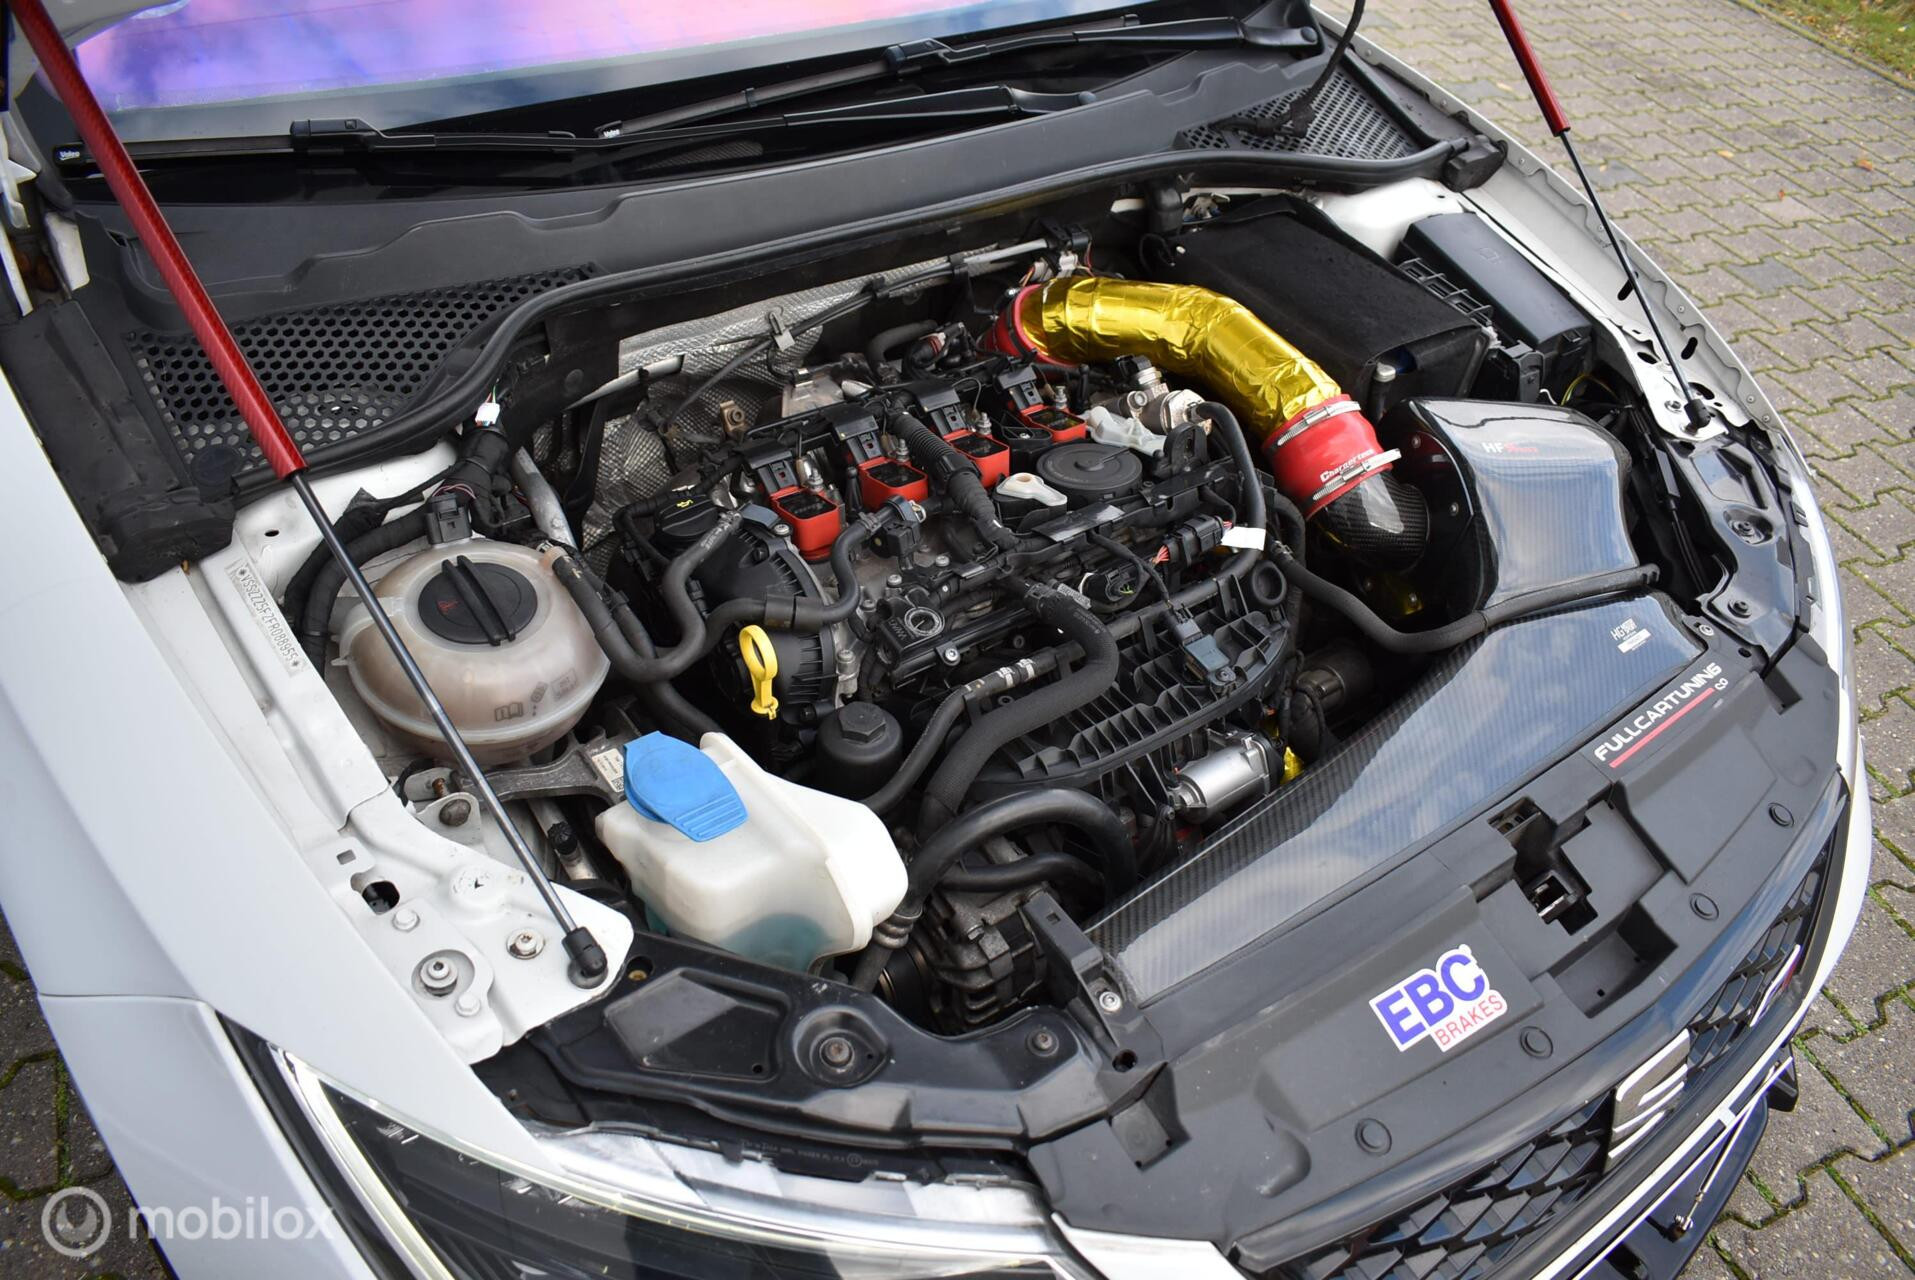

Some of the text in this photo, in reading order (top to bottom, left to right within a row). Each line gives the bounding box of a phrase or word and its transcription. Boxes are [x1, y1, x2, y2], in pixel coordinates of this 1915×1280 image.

[1594, 662, 1722, 761] FULLCARTUNING
[1375, 953, 1486, 1045] EBC
[1434, 994, 1503, 1046] BRAKES
